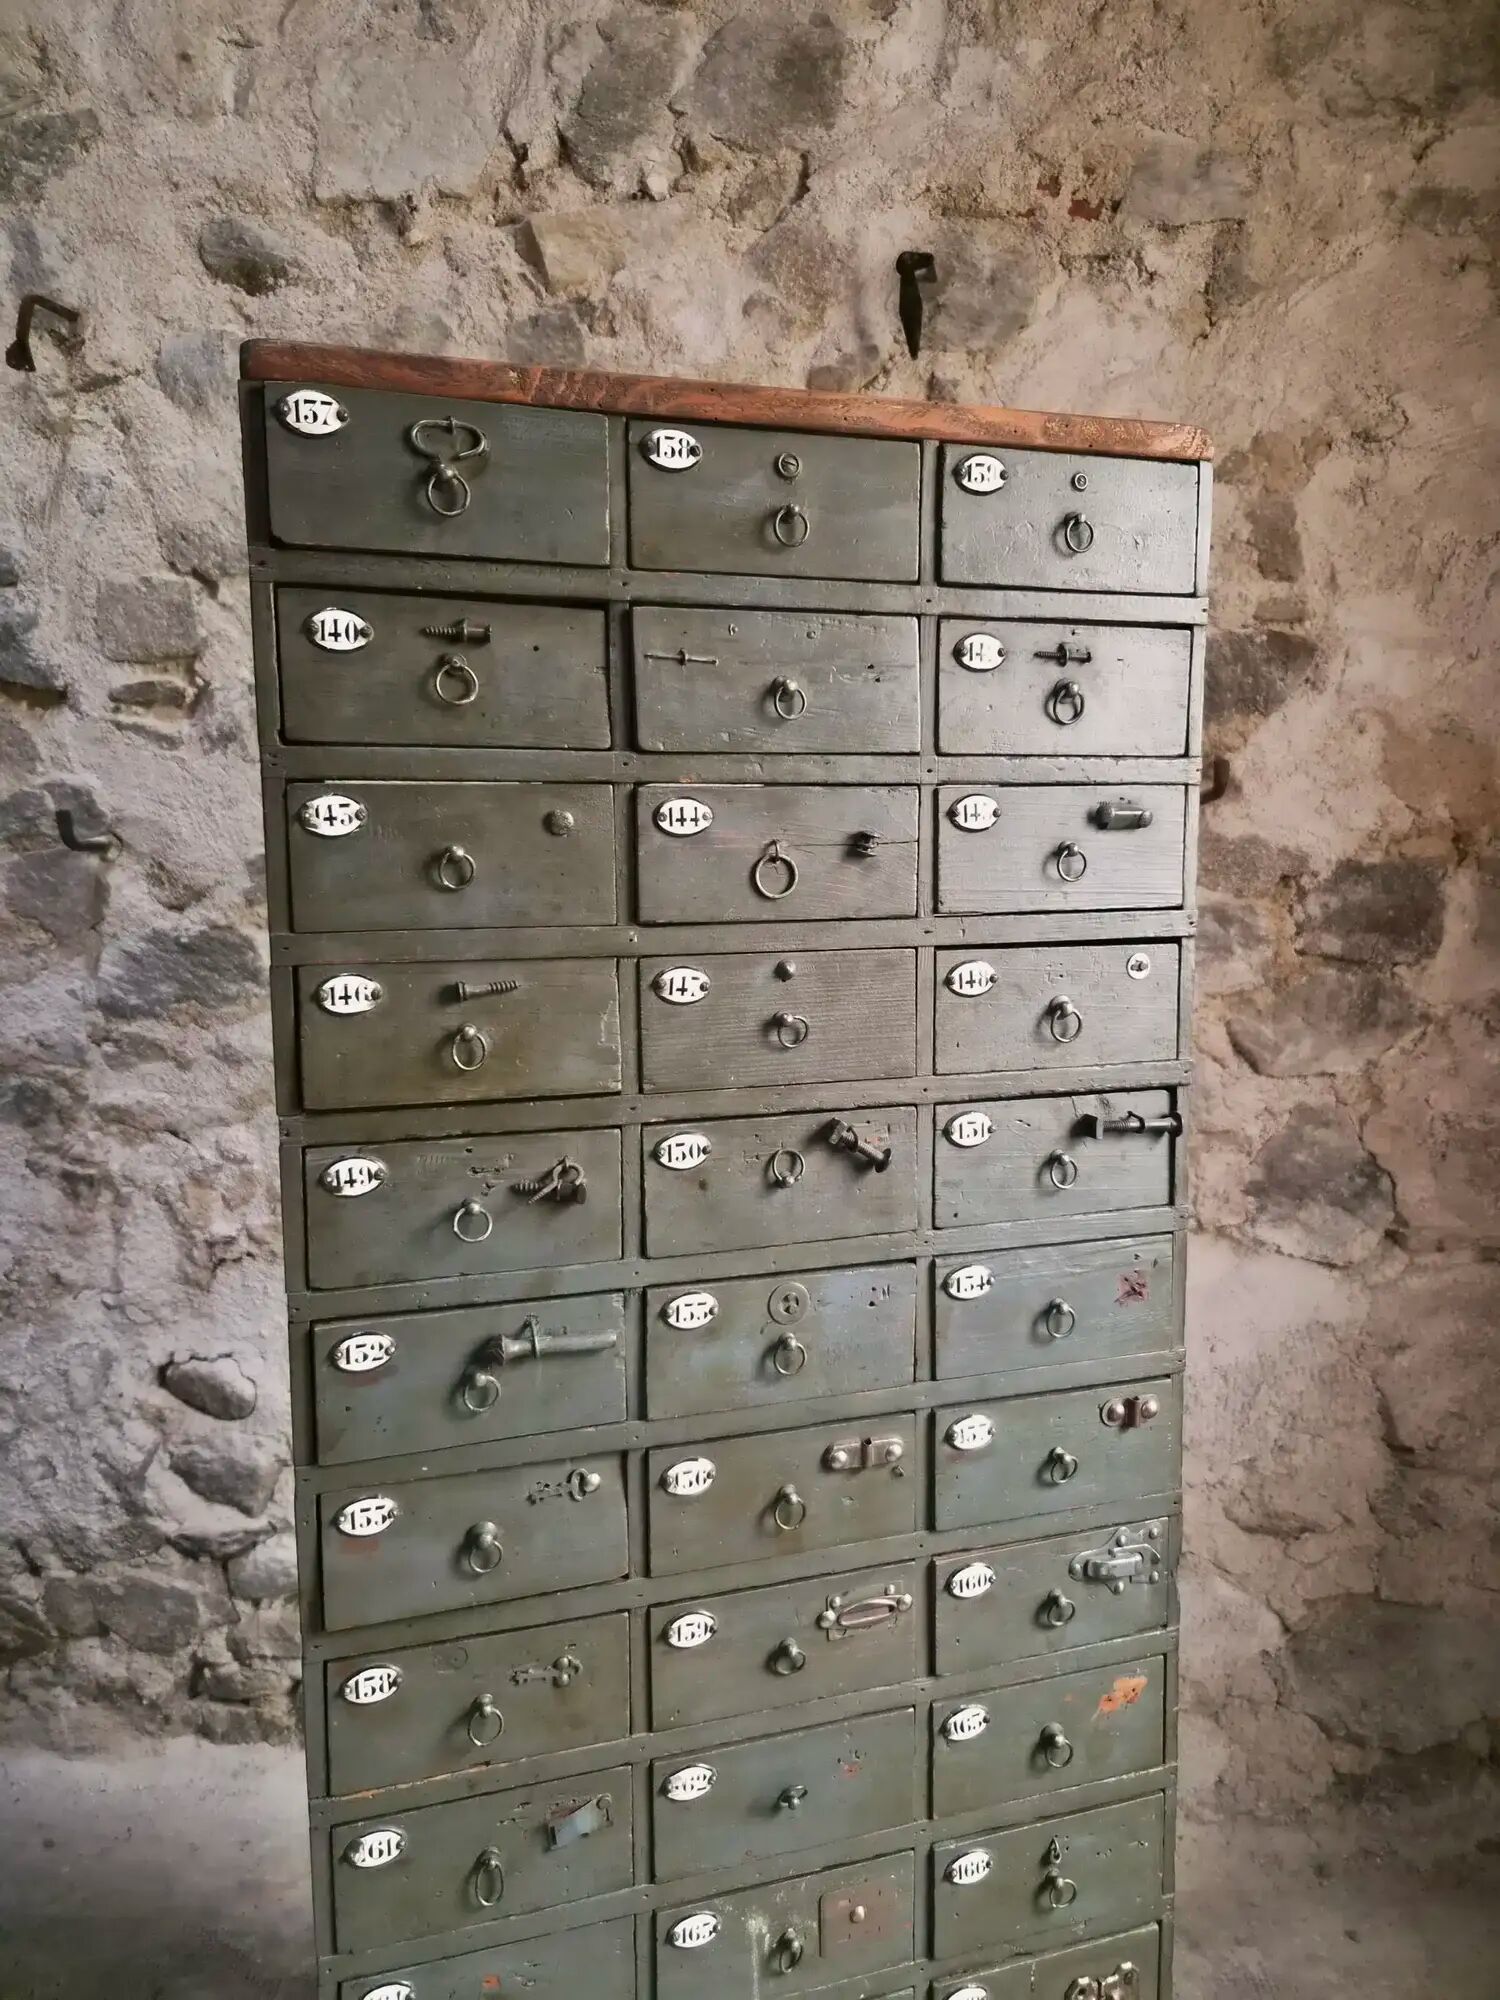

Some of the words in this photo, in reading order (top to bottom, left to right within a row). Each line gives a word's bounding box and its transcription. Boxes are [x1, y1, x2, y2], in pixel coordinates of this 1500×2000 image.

[293, 398, 334, 426] 137
[319, 619, 361, 645] 140
[668, 806, 701, 828] 144
